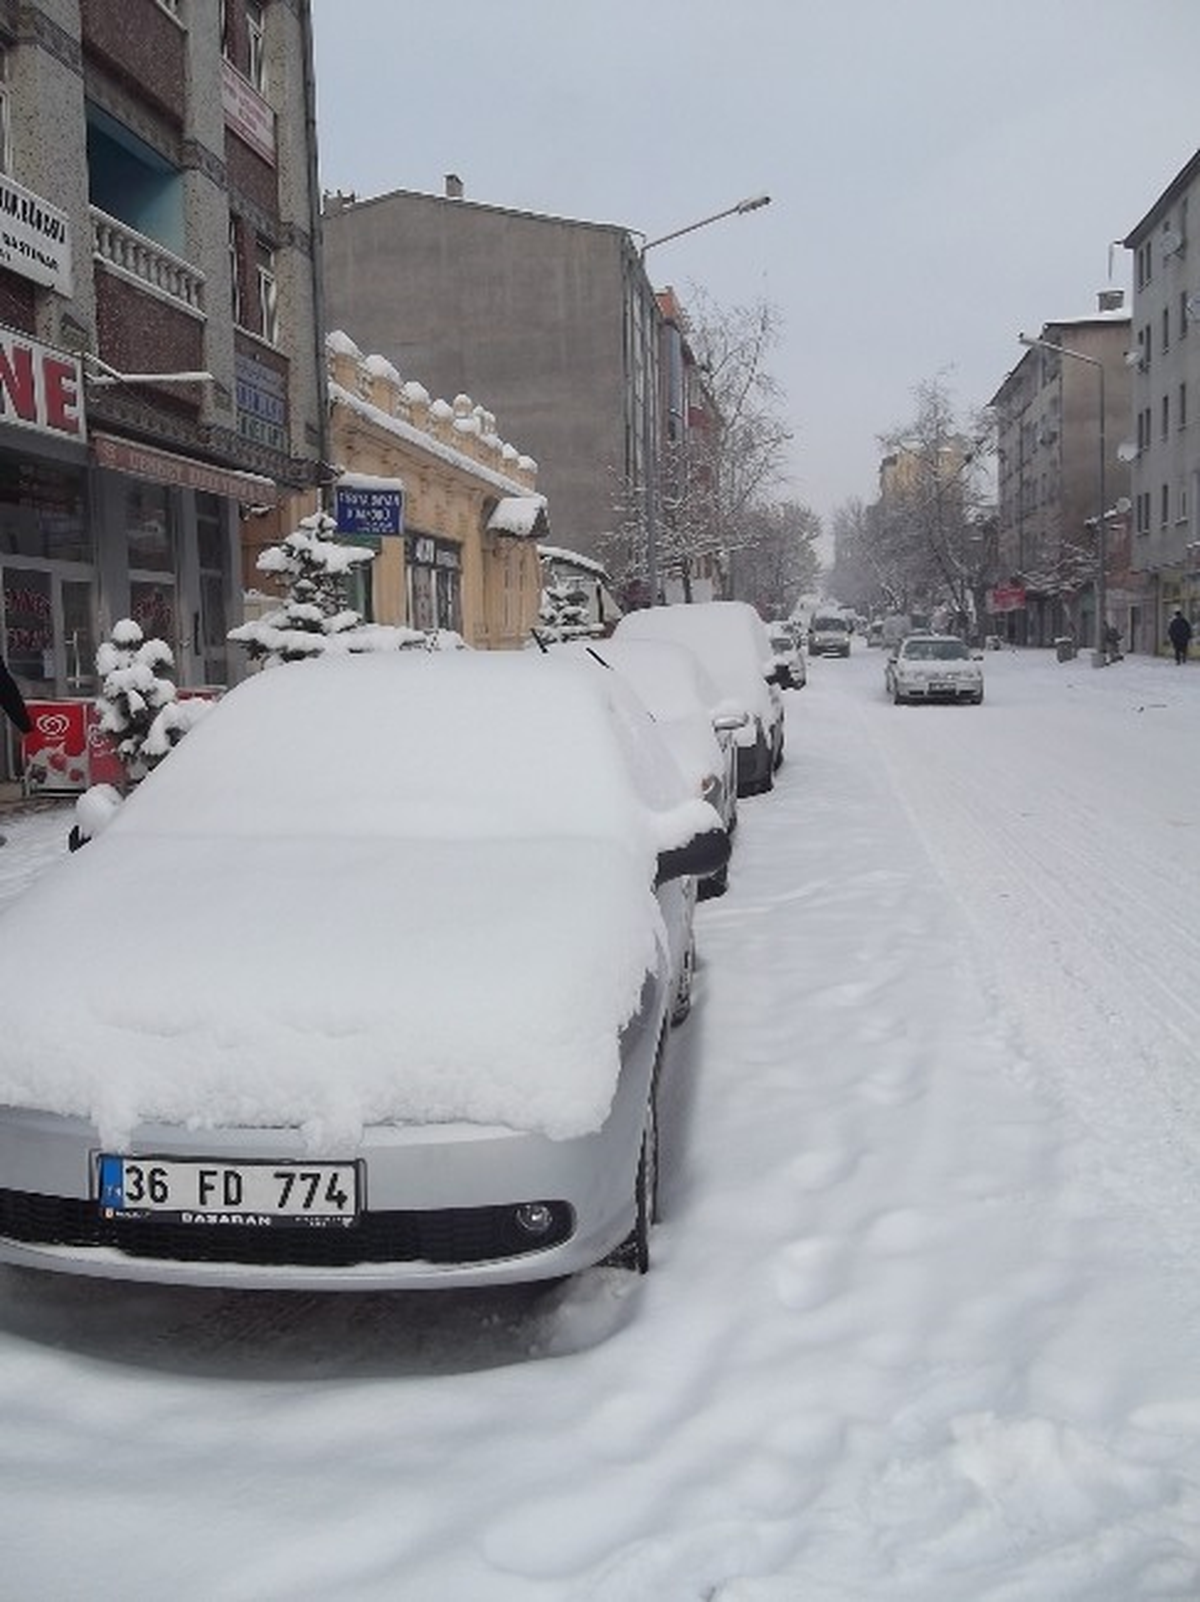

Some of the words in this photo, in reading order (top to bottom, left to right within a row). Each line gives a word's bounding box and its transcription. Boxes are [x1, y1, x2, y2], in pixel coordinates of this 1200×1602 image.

[125, 1165, 169, 1204] 36
[199, 1169, 243, 1206] FD
[273, 1172, 348, 1210] 774
